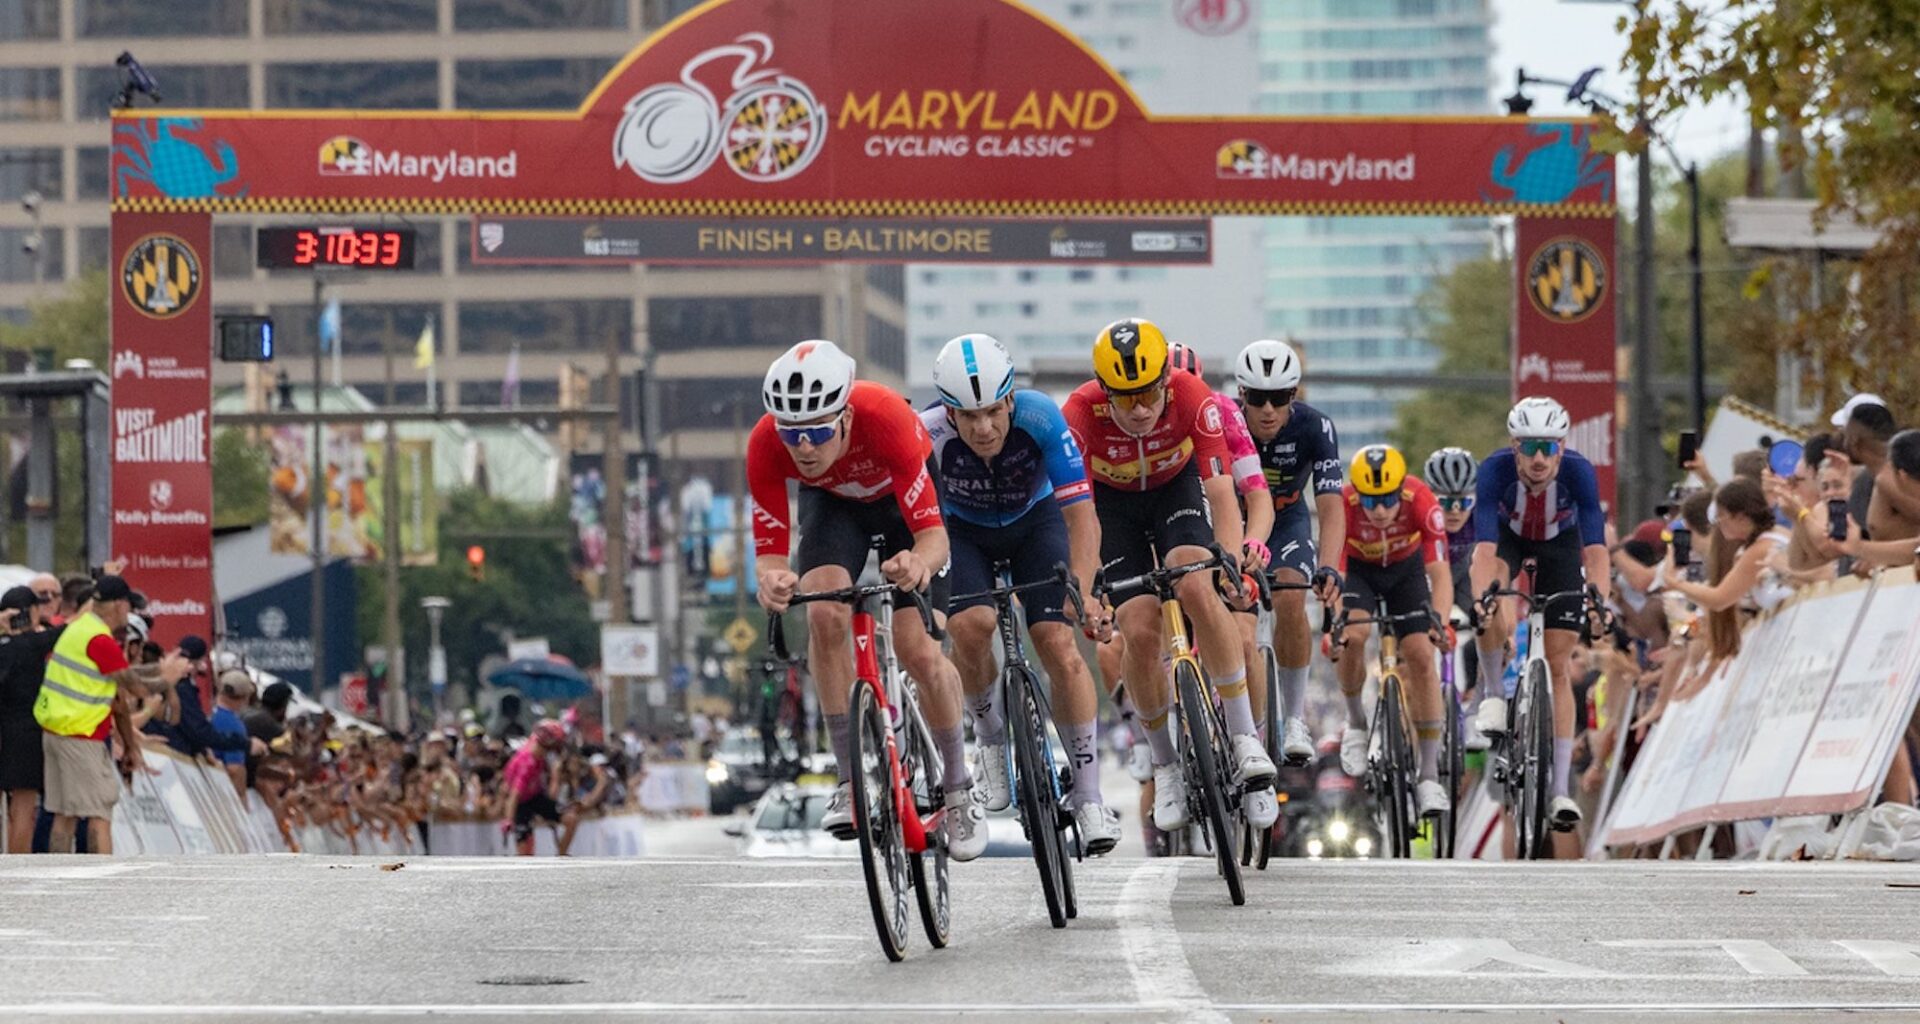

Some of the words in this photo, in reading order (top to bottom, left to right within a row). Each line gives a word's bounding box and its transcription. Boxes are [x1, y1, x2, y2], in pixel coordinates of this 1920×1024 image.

[837, 90, 1119, 130] MARYLAND
[864, 136, 971, 157] CYCLING
[976, 136, 1076, 157] CLASSIC
[373, 149, 517, 182] Maryland
[1271, 152, 1415, 186] Maryland
[294, 232, 400, 265] 3:10:33
[698, 229, 792, 251] FINISH
[823, 228, 992, 252] BALTIMORE
[115, 408, 155, 435] VISIT
[116, 409, 206, 462] BALTIMORE
[115, 511, 150, 526] Kelly
[151, 510, 207, 524] Benefits
[139, 555, 181, 568] Harbor
[183, 555, 207, 568] East
